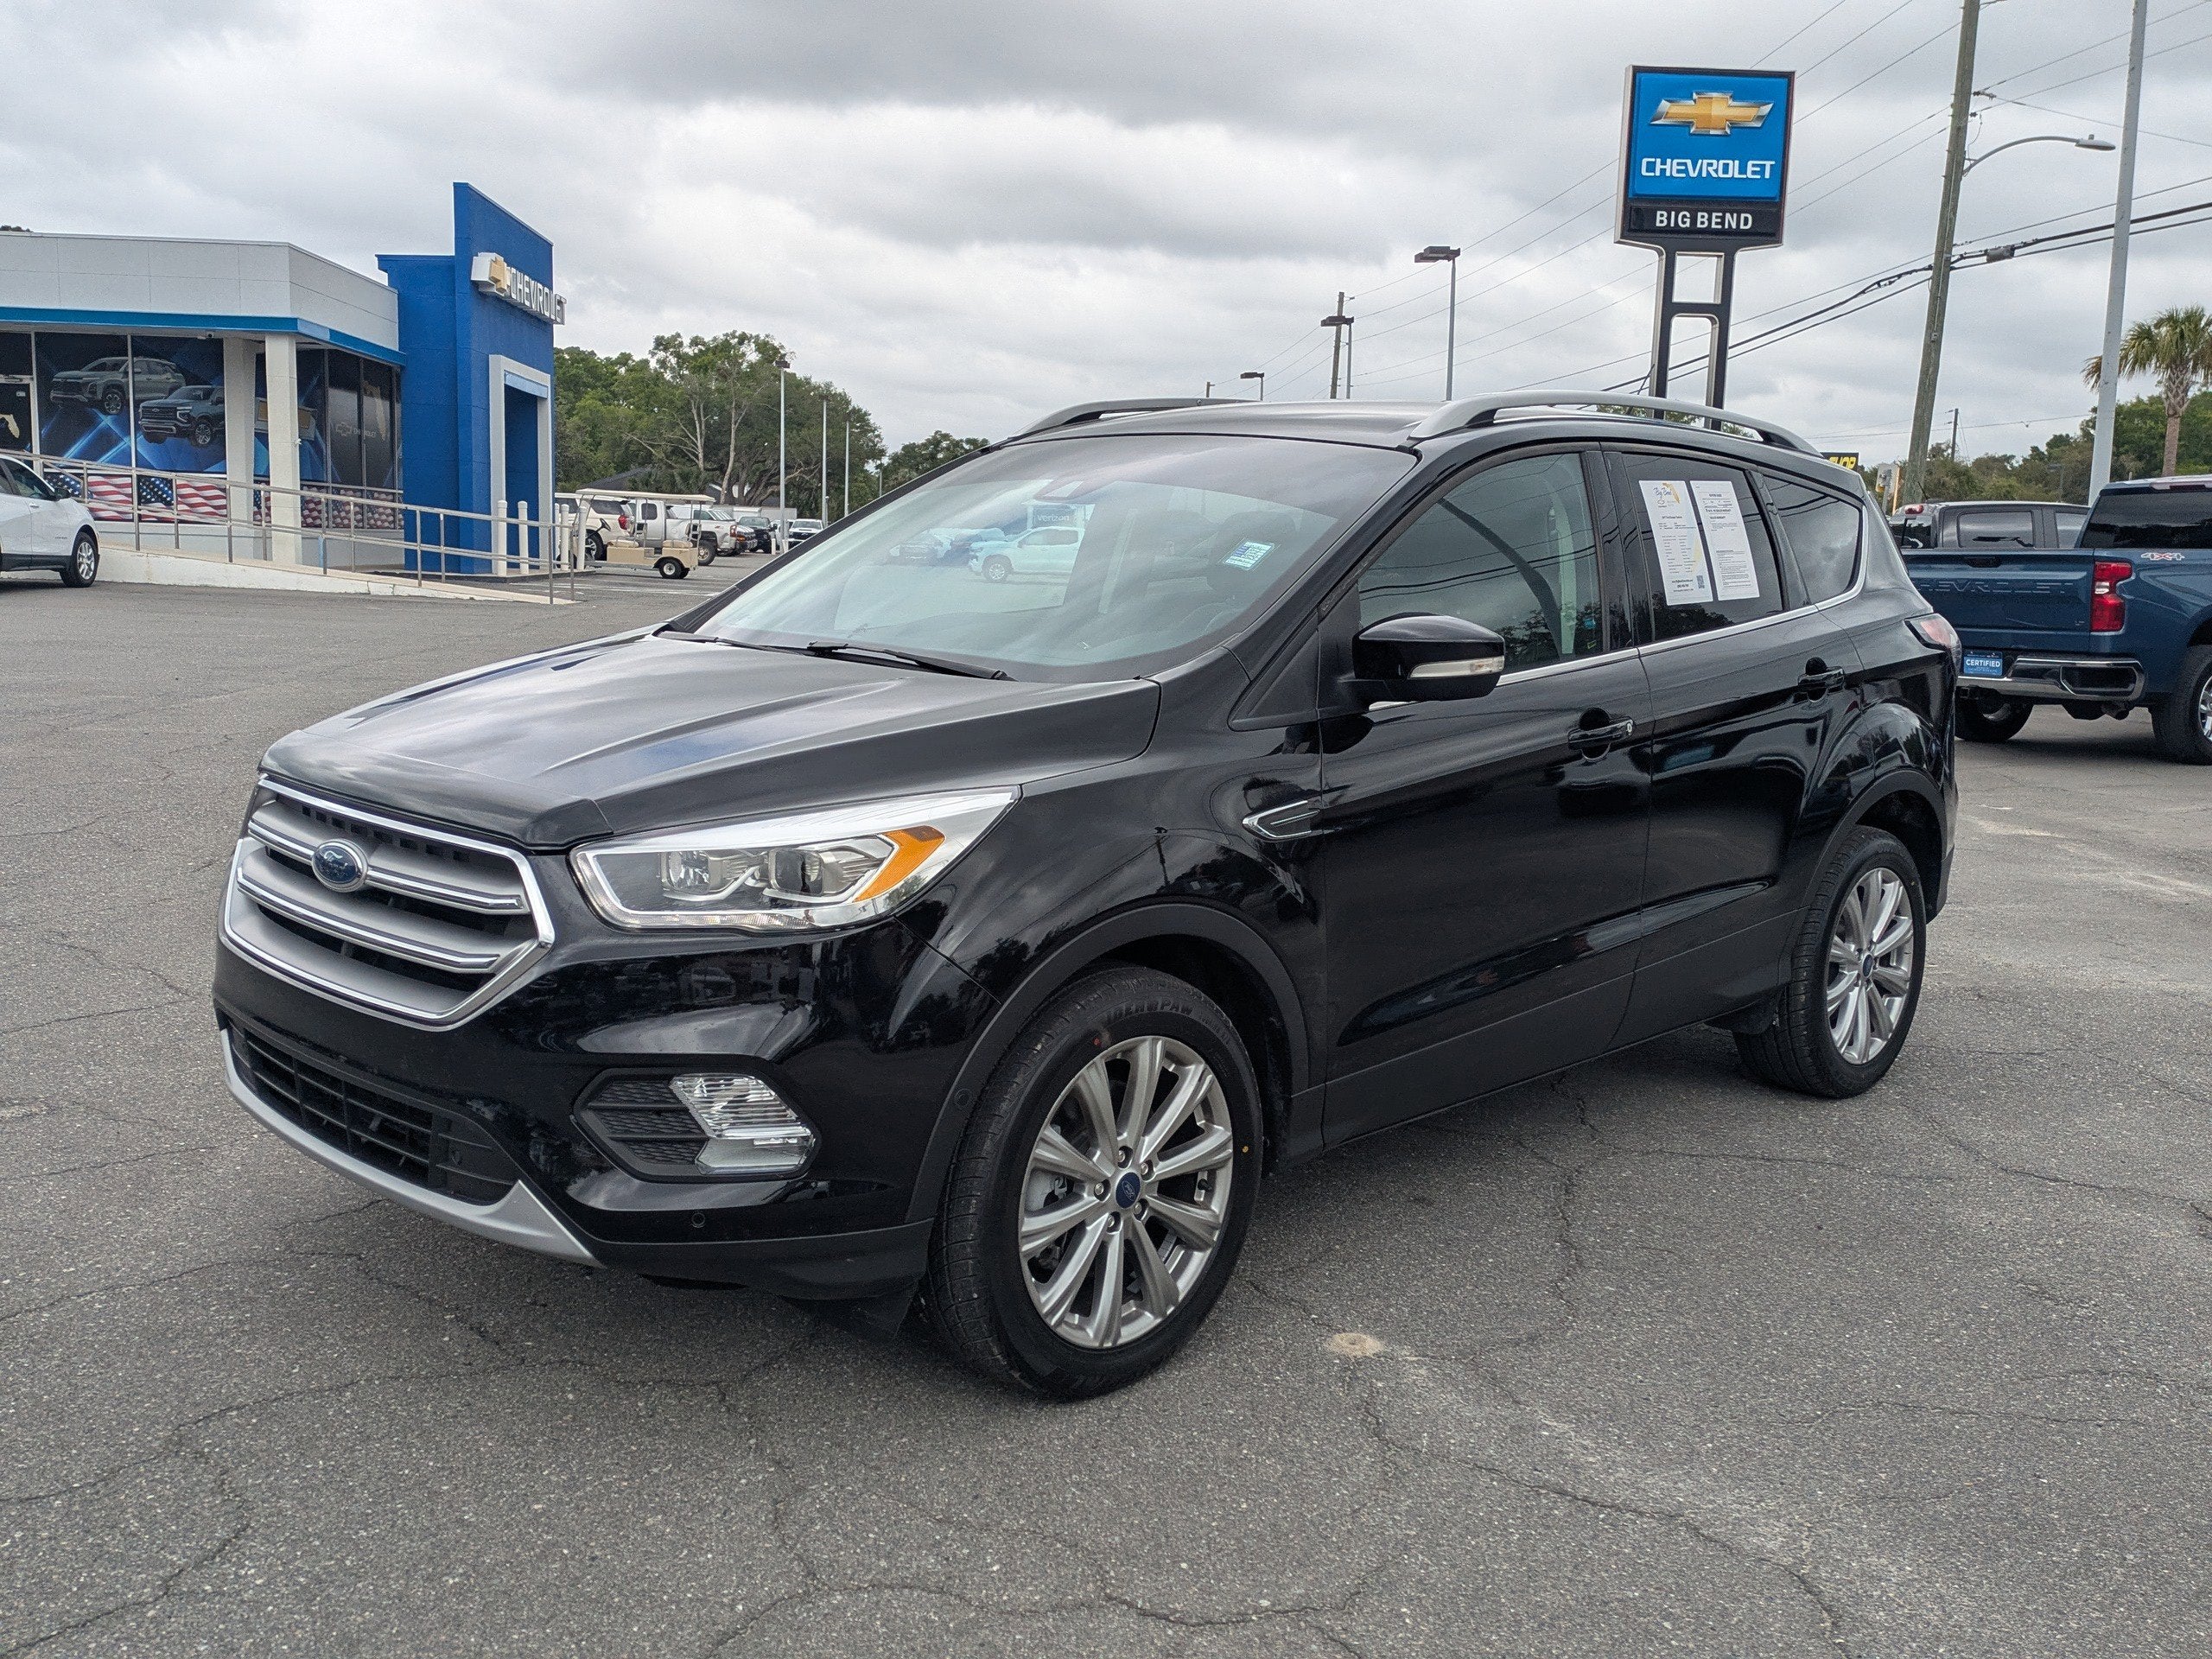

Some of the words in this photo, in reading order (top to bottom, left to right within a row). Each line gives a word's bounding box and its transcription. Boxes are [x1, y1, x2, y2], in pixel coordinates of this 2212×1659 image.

[1641, 158, 1776, 179] CHEVROLET
[1656, 210, 1691, 228] BIG
[1696, 212, 1753, 230] BEND
[510, 267, 568, 325] CHEVROLET
[1913, 581, 2074, 594] HEVROLET
[1966, 658, 2001, 668] CERTIFIED
